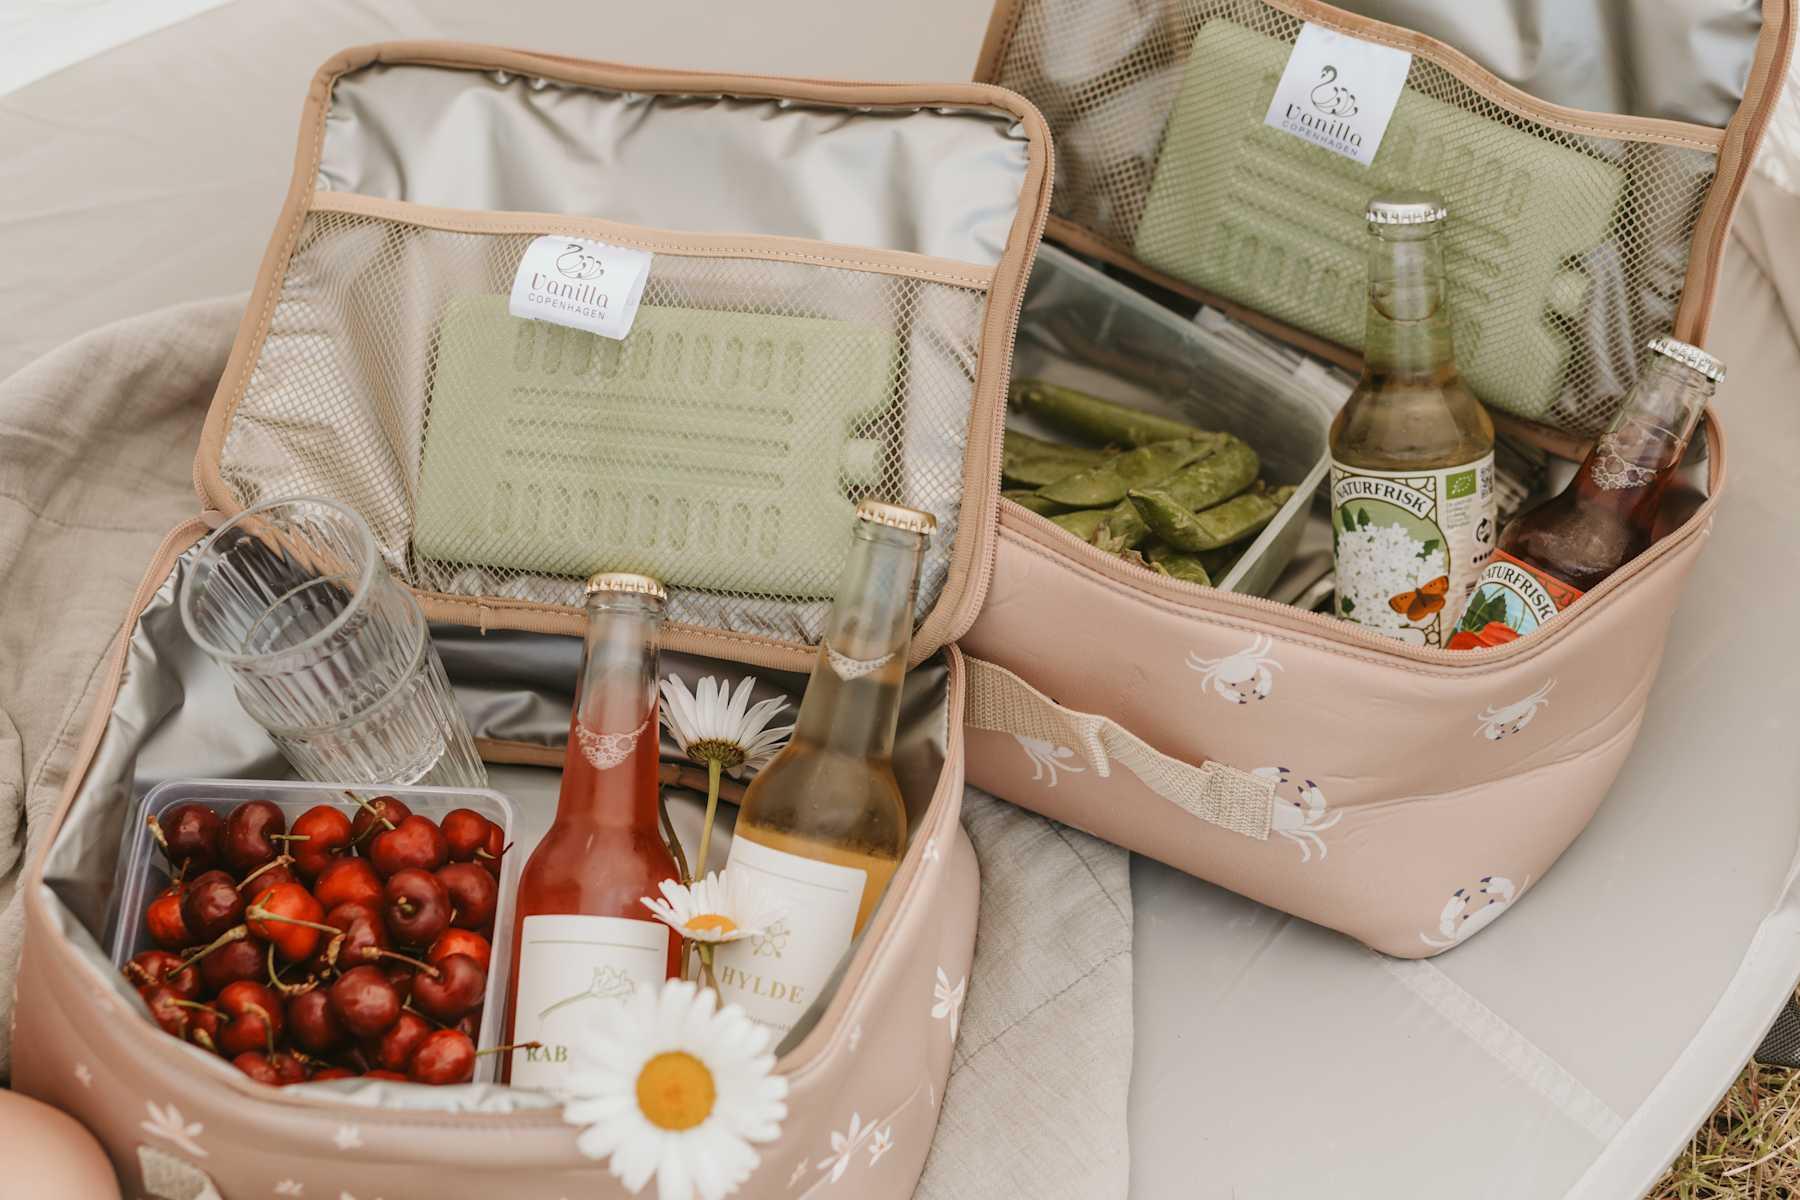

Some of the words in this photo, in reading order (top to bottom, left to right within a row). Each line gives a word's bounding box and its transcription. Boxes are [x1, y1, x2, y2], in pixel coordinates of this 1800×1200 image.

[1282, 121, 1358, 156] COPENHAGEN
[1286, 103, 1362, 147] Vanilla
[528, 293, 606, 320] COPENHAGEN
[531, 272, 608, 309] Vanilla
[1336, 481, 1427, 513] NATURFRISK
[1481, 565, 1553, 620] ATURFRISK
[721, 965, 804, 1004] HYLDE
